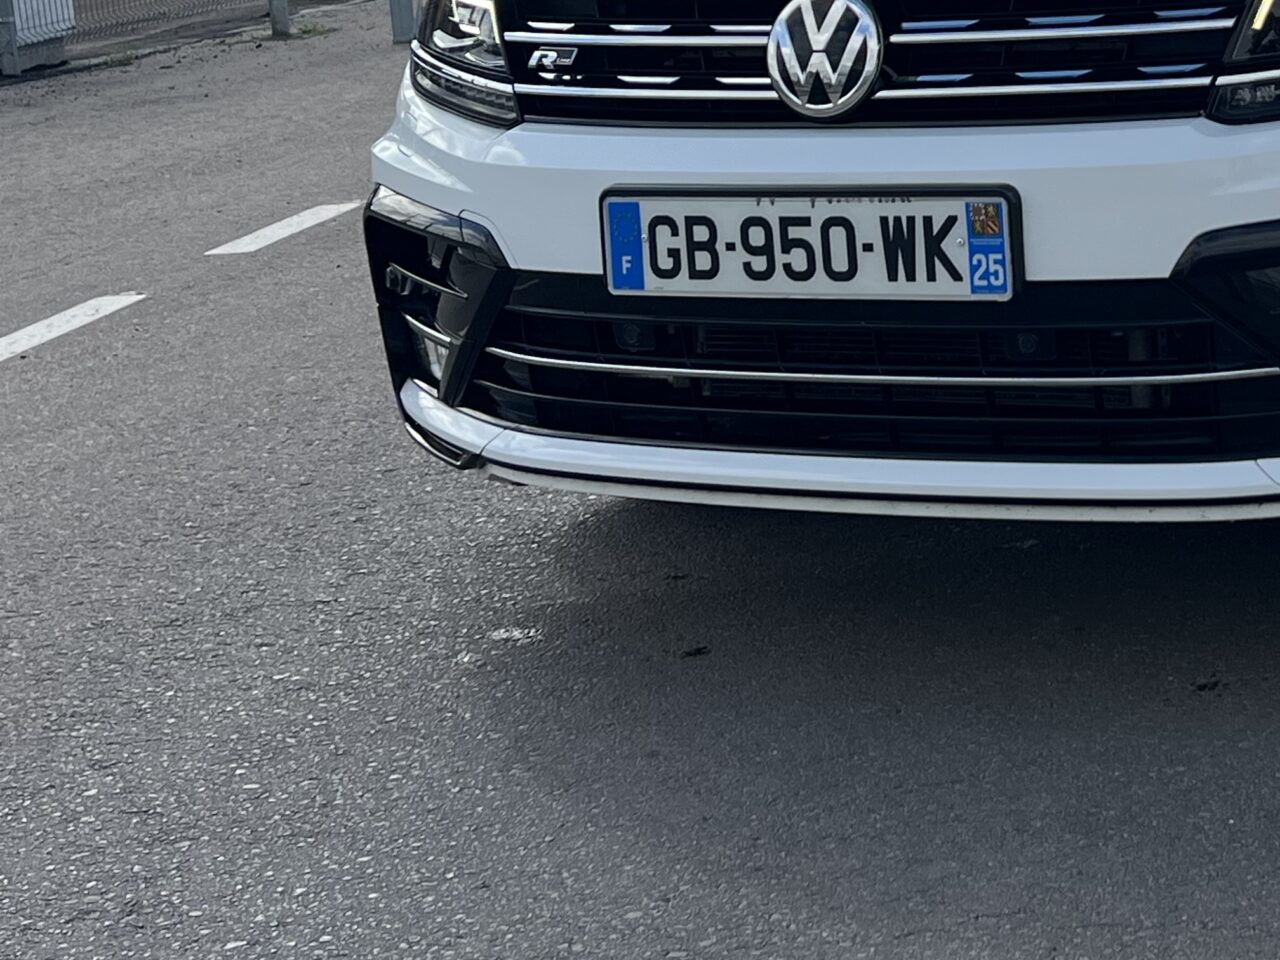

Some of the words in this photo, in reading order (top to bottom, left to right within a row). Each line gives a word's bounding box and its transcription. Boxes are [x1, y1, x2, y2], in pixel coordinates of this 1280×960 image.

[527, 49, 558, 69] R
[646, 214, 965, 284] GB-950-WK
[620, 255, 632, 275] F
[971, 252, 1005, 287] 25
